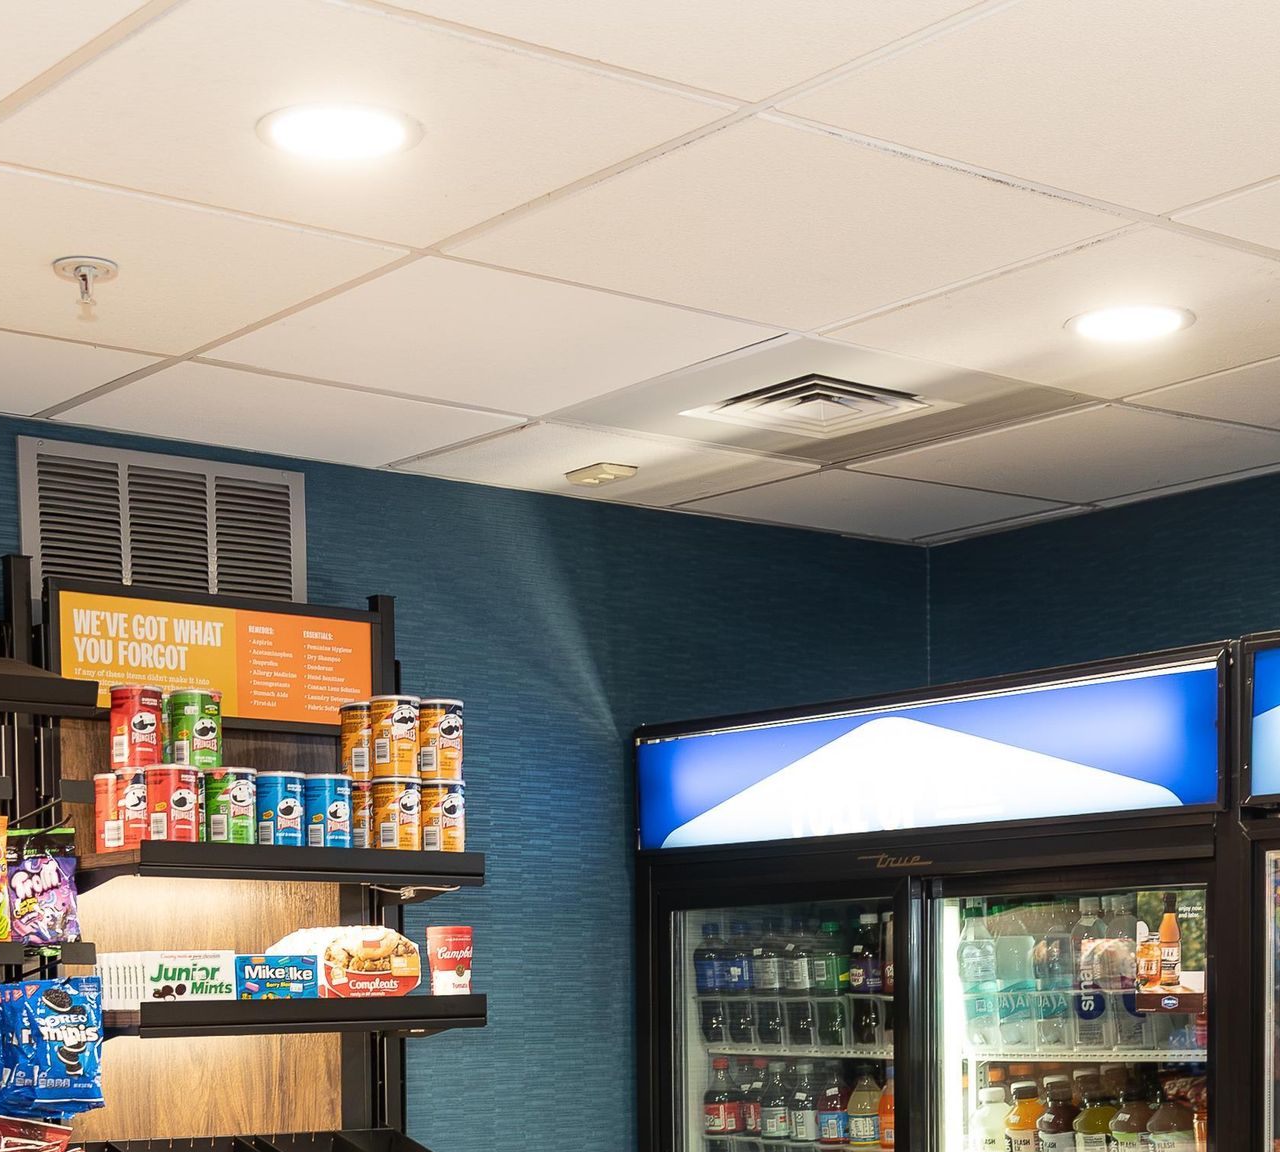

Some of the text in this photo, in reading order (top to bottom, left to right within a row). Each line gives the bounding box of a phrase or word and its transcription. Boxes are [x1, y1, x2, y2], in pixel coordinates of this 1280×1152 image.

[73, 608, 224, 647] WE'VE GOT WHAT
[73, 636, 188, 672] YOU FORGOT
[97, 669, 105, 677] of
[106, 670, 125, 679] these
[126, 672, 146, 681] items
[169, 675, 187, 684] make
[149, 963, 220, 984] Junior
[245, 965, 313, 982] Mike Ike
[191, 979, 233, 997] Mints
[348, 978, 400, 993] Compleats
[42, 1014, 88, 1026] OREO
